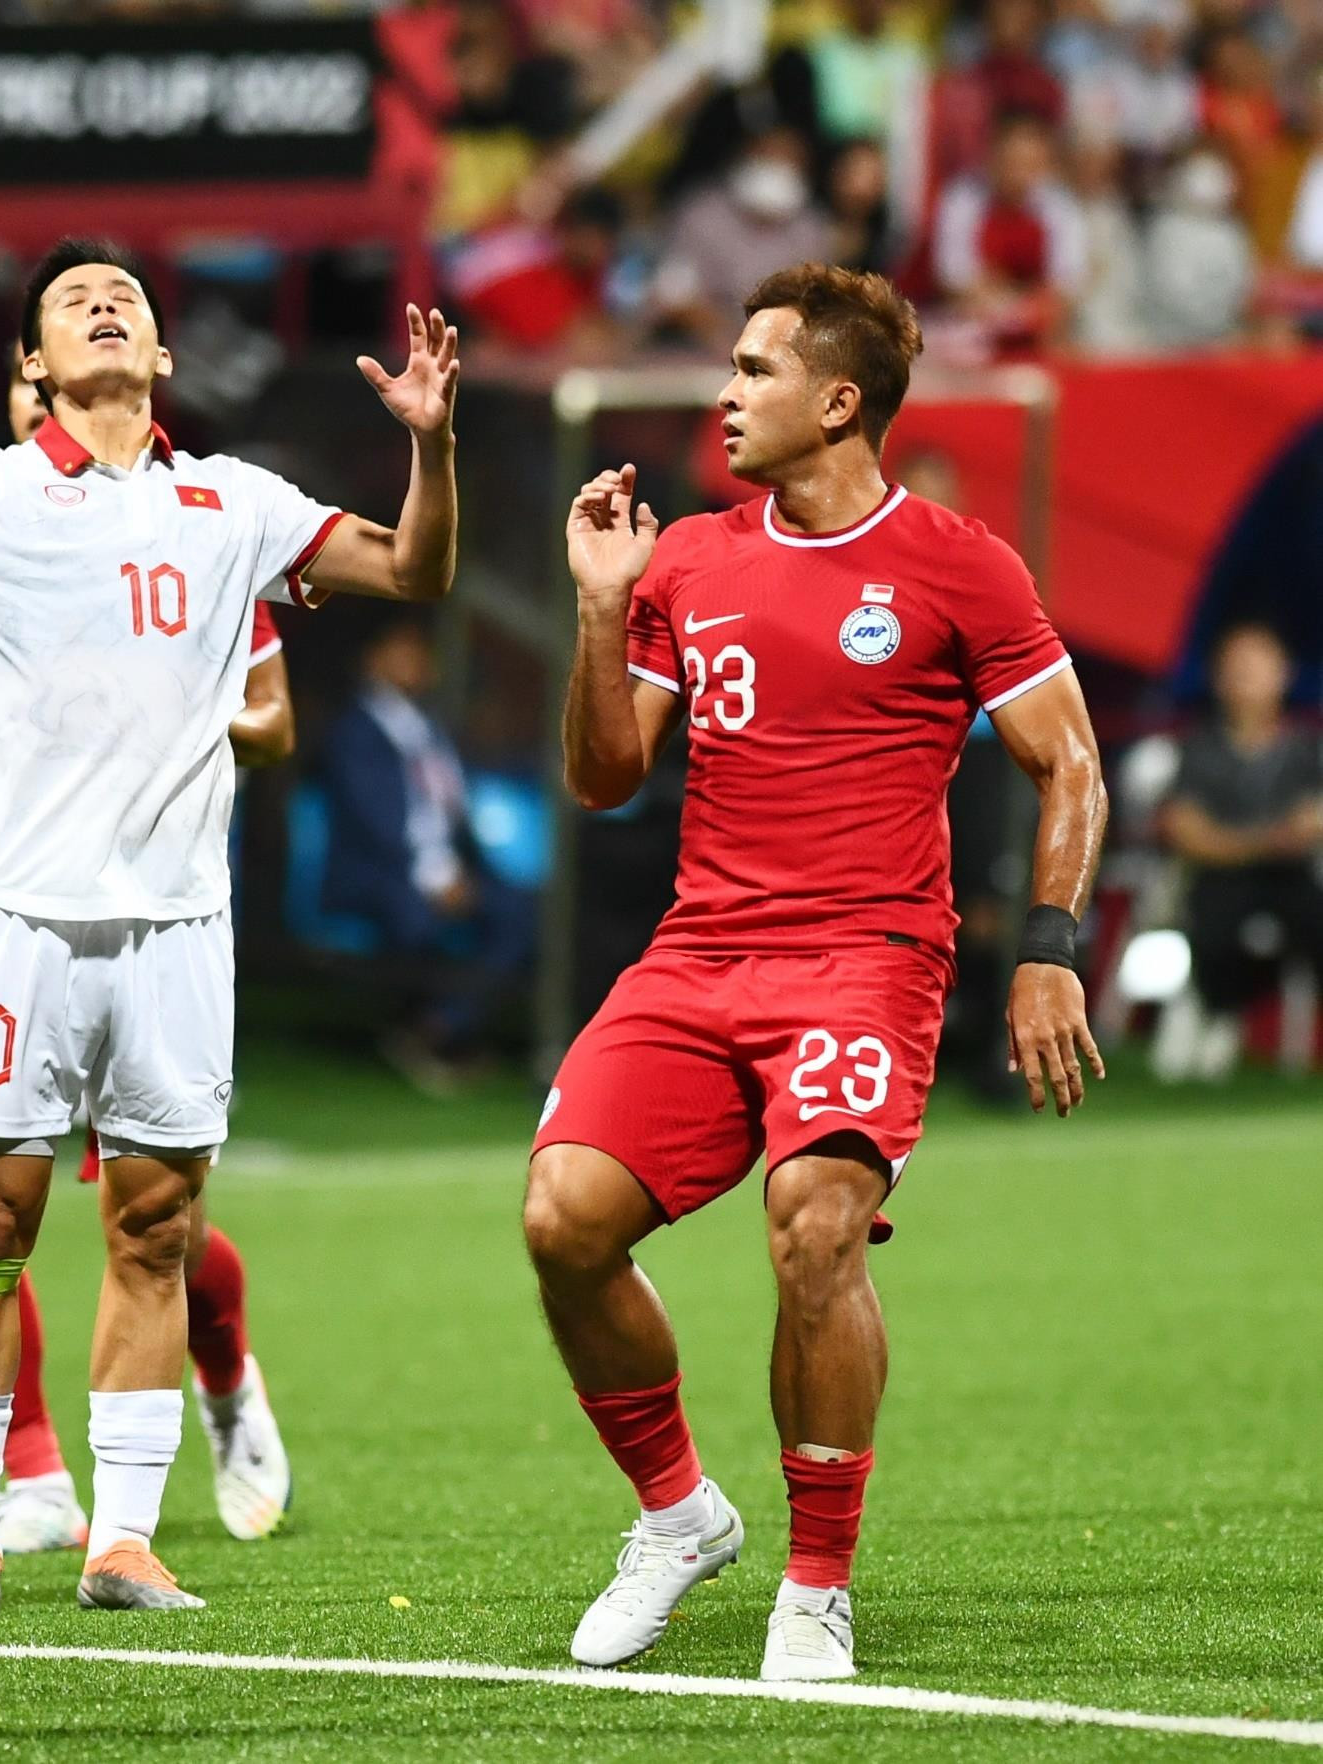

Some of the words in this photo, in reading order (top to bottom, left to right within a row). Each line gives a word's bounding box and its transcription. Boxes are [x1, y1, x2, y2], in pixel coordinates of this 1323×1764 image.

[88, 56, 217, 138] CUP
[224, 54, 365, 137] 2022
[120, 562, 187, 637] 10
[683, 644, 756, 731] 23
[788, 1028, 892, 1113] 23
